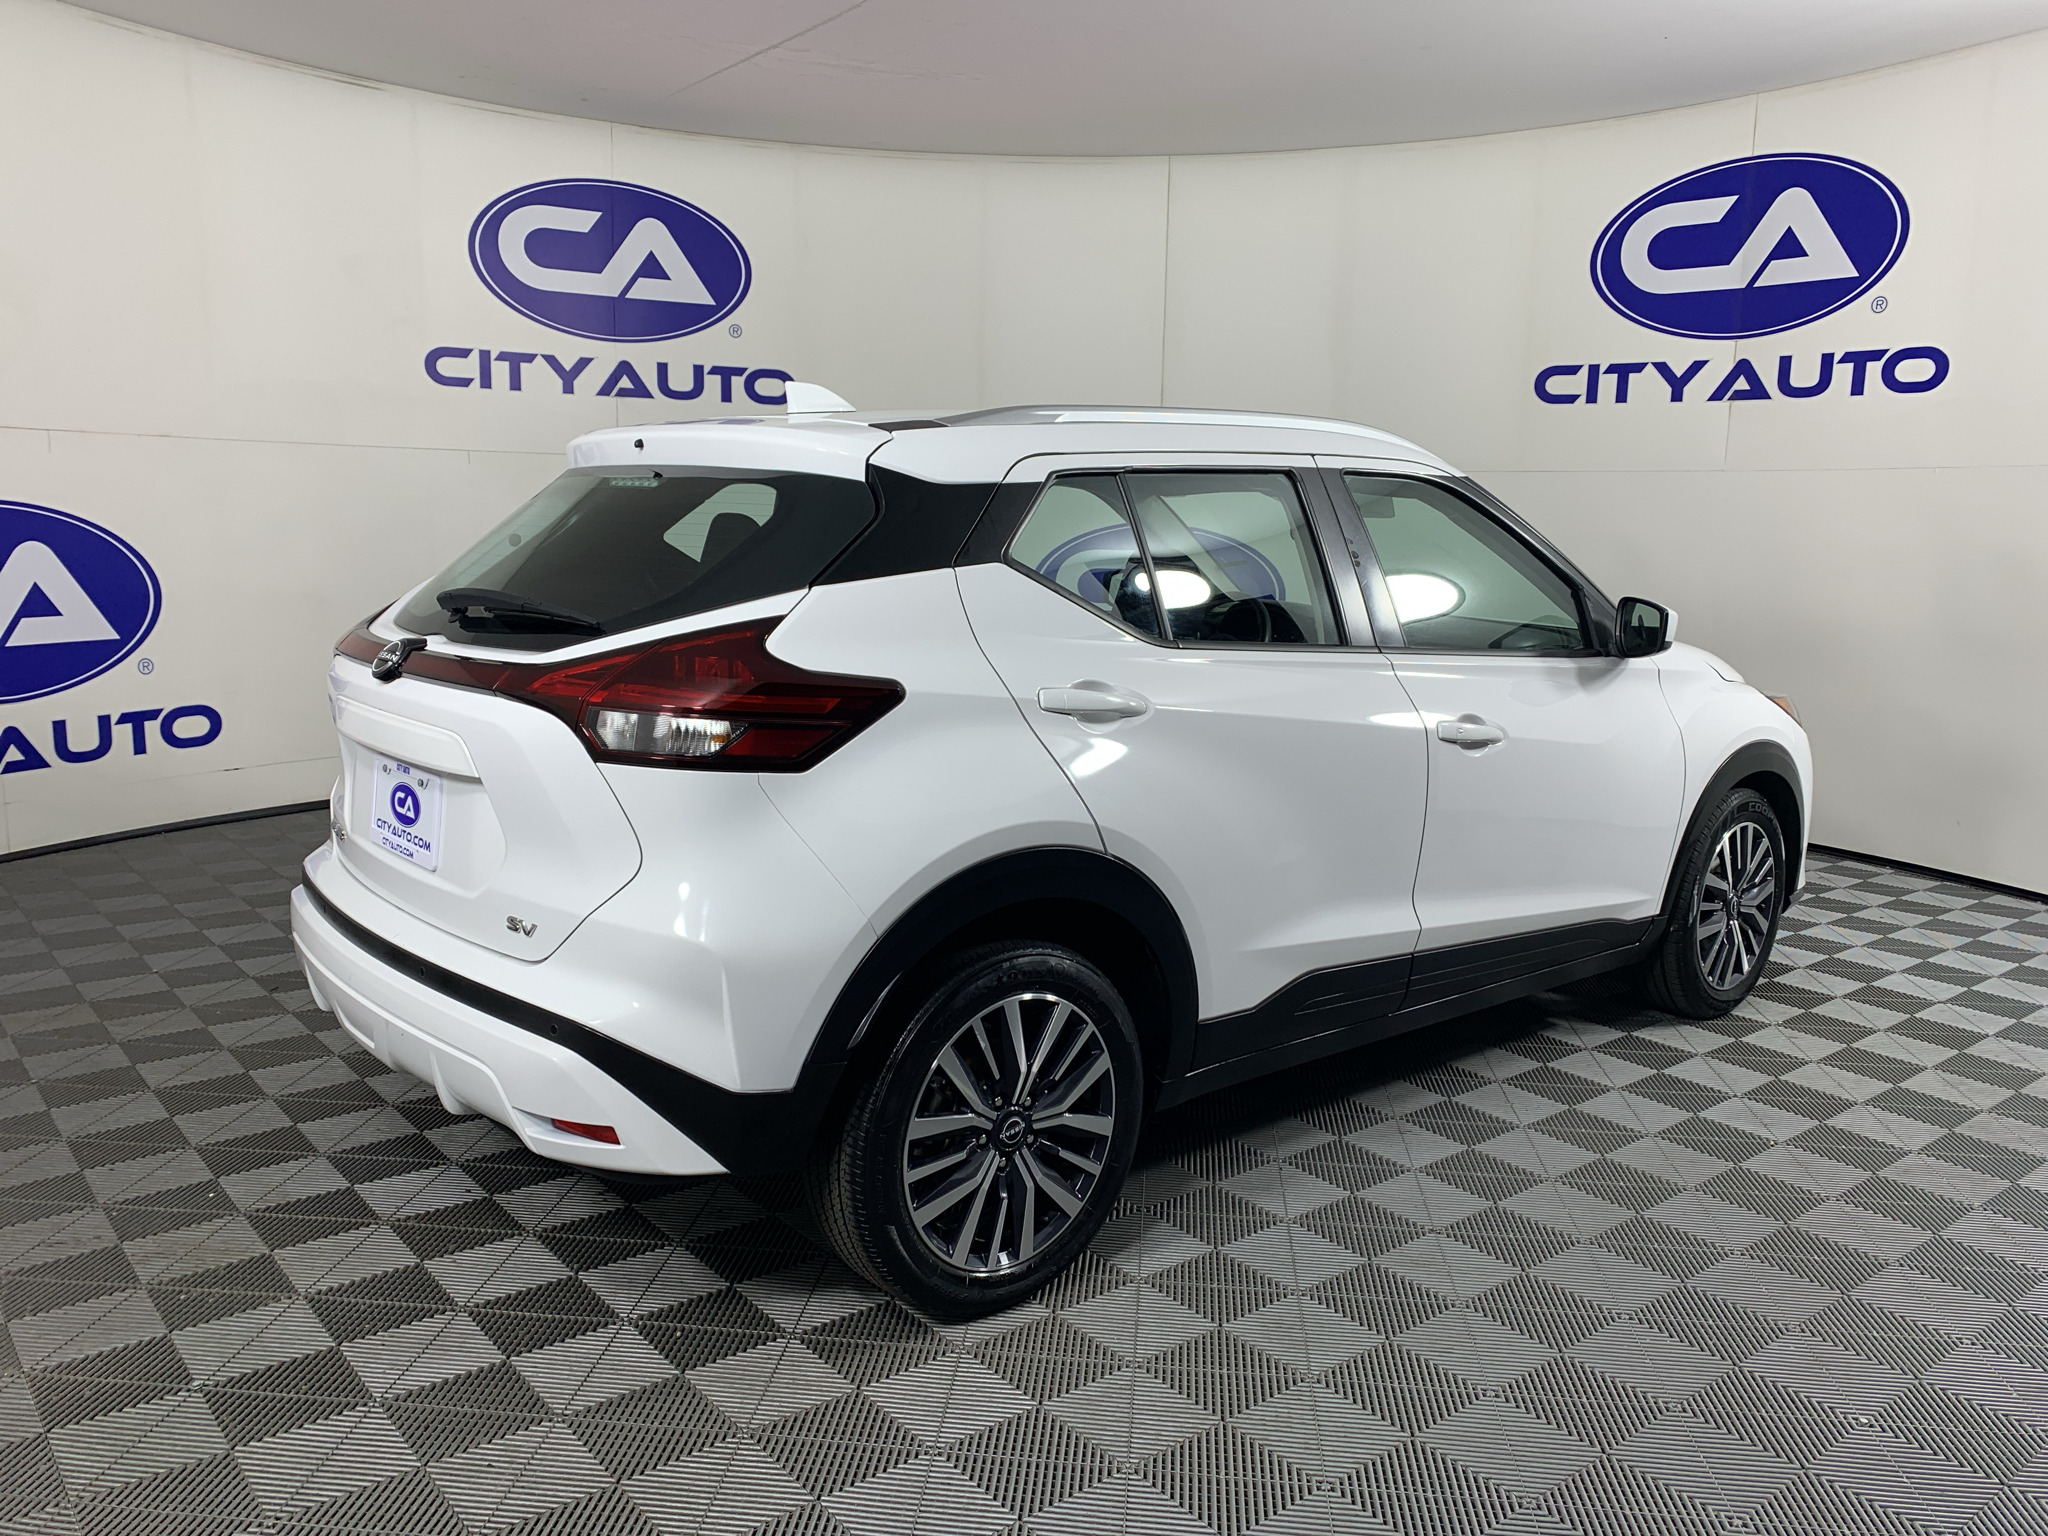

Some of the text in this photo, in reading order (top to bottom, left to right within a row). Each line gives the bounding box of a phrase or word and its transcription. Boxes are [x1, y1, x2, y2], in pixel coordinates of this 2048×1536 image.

[498, 204, 718, 306] CA
[1620, 186, 1860, 295] CA
[394, 790, 416, 820] CA
[376, 817, 432, 853] CITYAUTO.COM
[381, 836, 415, 859] CITYAUTO.COM
[505, 915, 539, 939] SV
